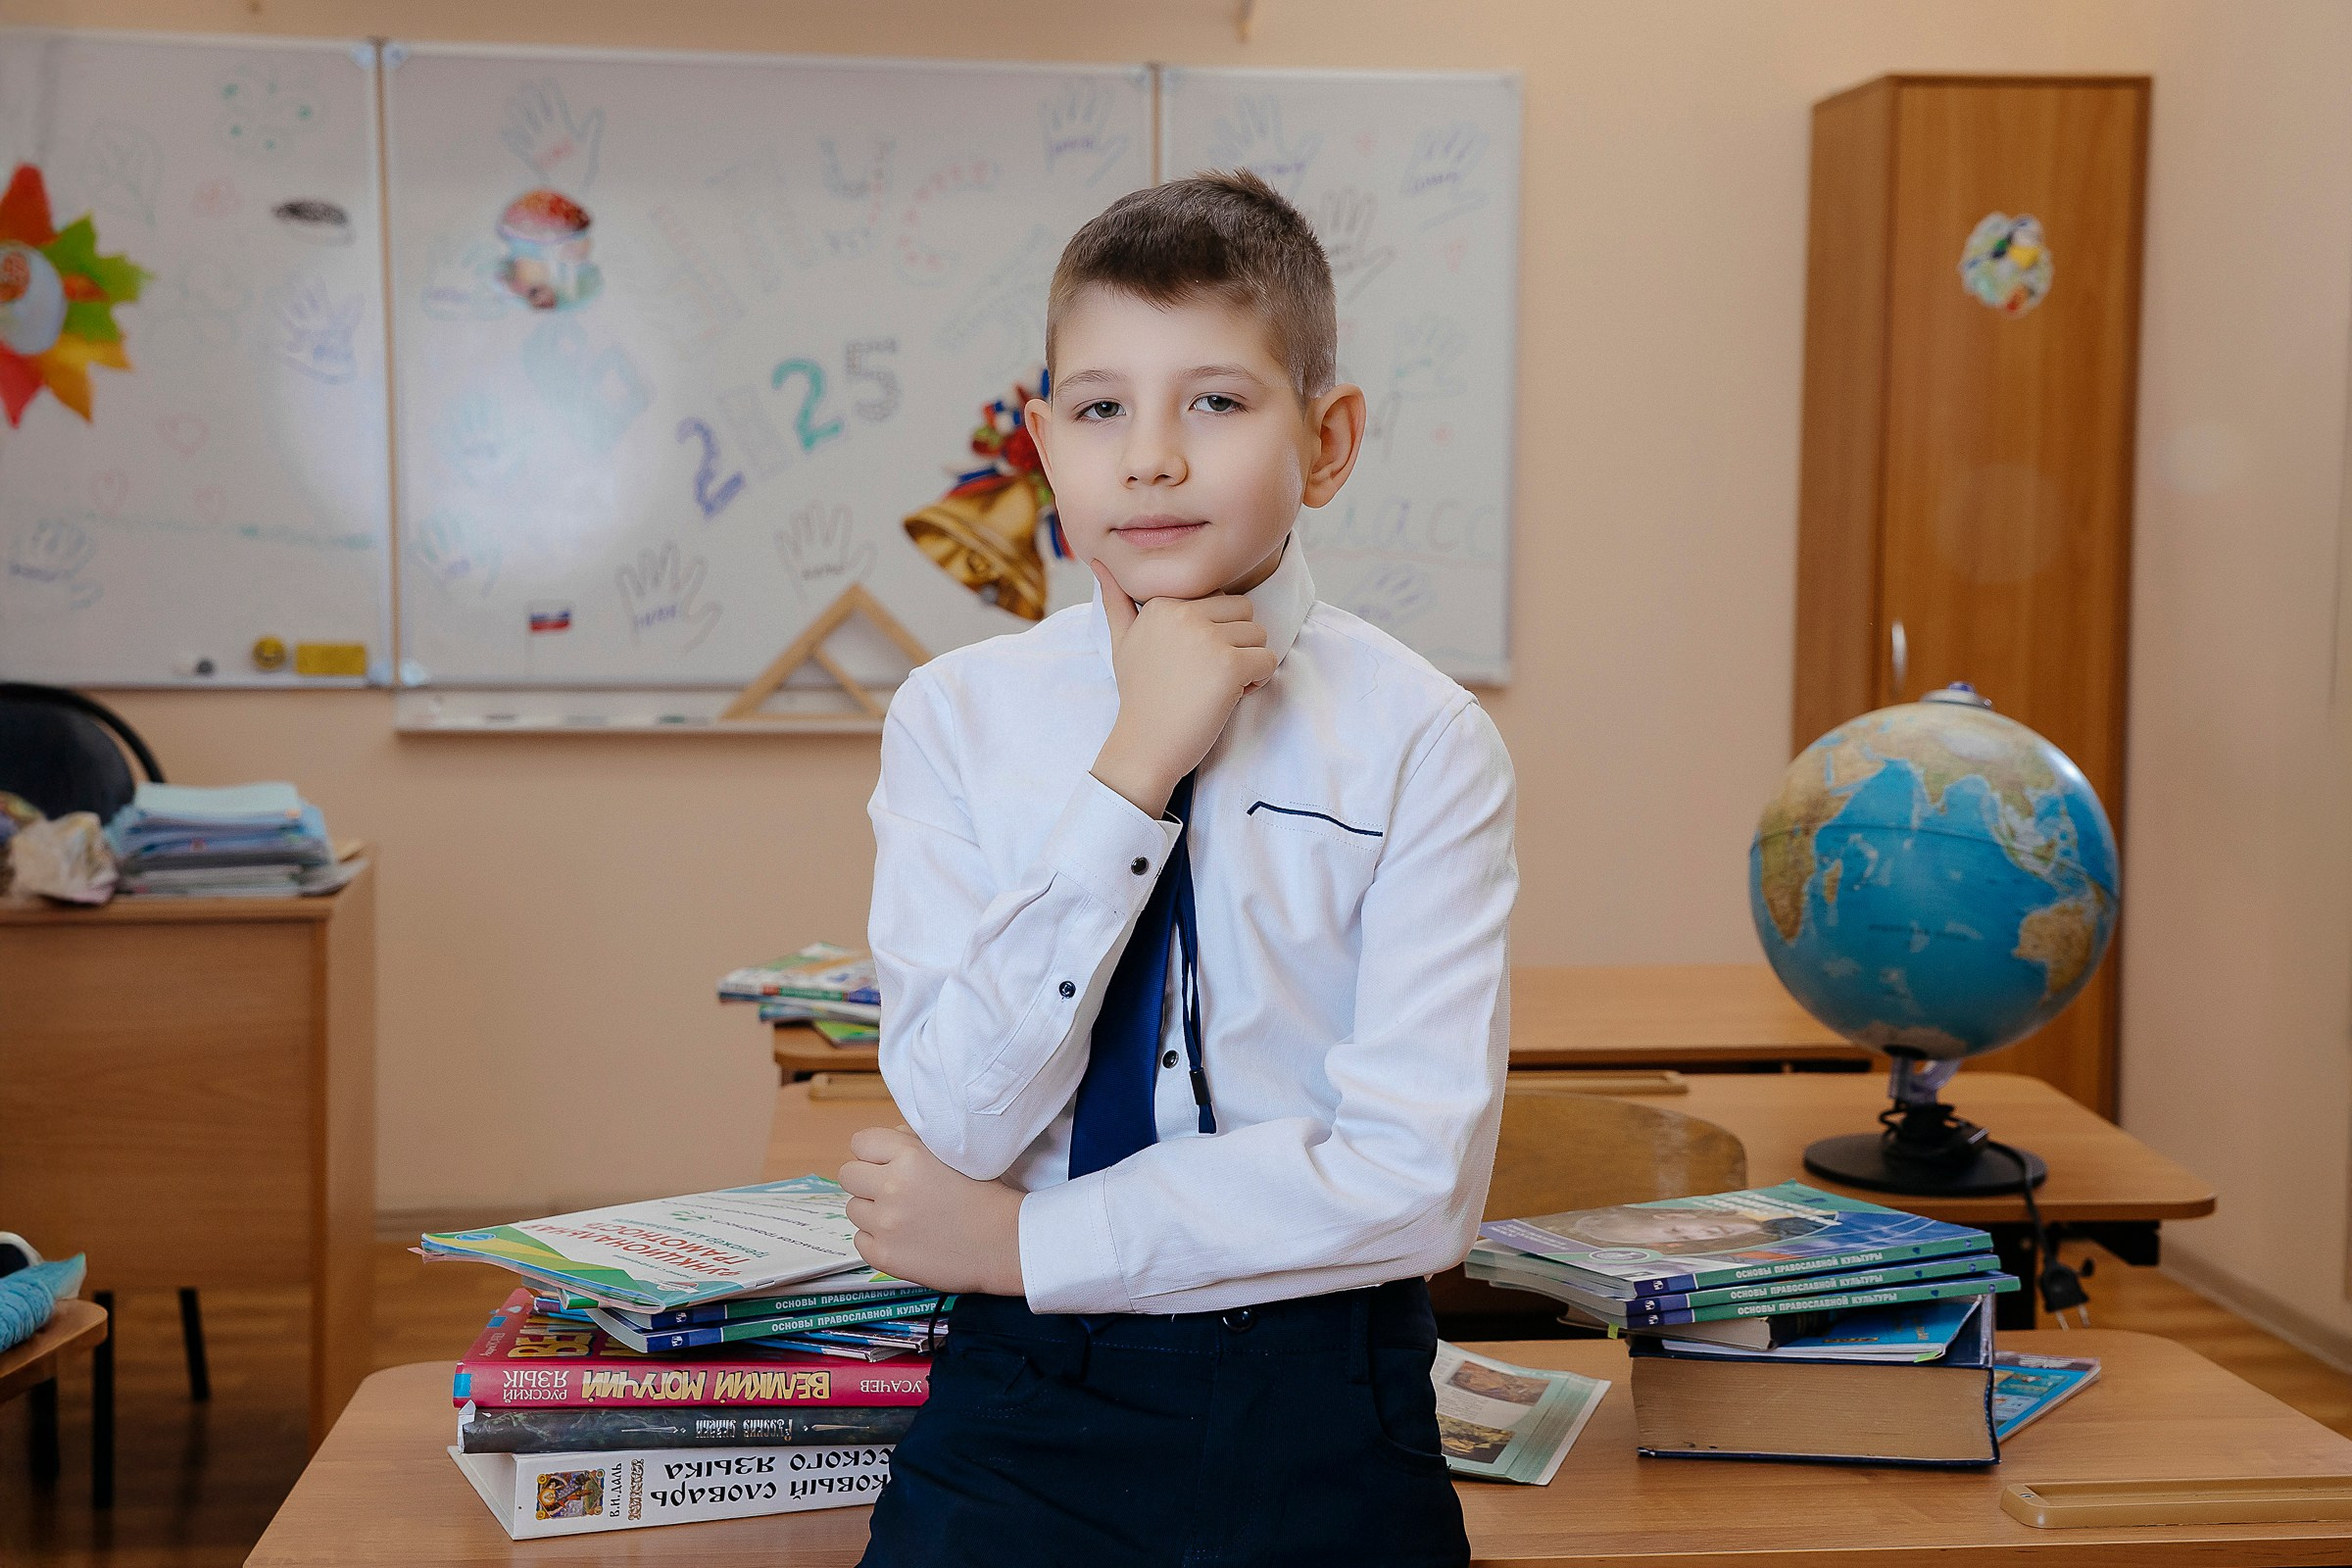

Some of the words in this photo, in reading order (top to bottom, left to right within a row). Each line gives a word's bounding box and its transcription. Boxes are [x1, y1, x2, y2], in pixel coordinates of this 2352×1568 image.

[521, 1224, 742, 1278] ФУНКЦИОНАЛЬНАЯ
[585, 1222, 752, 1265] ГРАМОТНОСТЬ
[1736, 1266, 1772, 1279] ОСНОВЫ
[1775, 1256, 1838, 1274] ПРАВОСЛАВНОЙ
[1841, 1251, 1883, 1265] КУЛЬТУРЫ
[1730, 1287, 1767, 1299] ОСНОВЫ
[1771, 1278, 1838, 1295] ПРАВОСЛАВНОЙ
[1840, 1274, 1883, 1287] КУЛЬТУРЫ
[775, 1298, 817, 1310] ОСНОВЫ
[821, 1289, 895, 1304] ПРАВОСЛАВНОЙ
[1738, 1302, 1776, 1315] ОСНОВЫ
[1779, 1295, 1849, 1311] ПРАВОСЛАВНОЙ
[1851, 1292, 1897, 1304] КУЛЬТУРЫ
[771, 1317, 813, 1332] ОСНОВЫ
[817, 1306, 893, 1327] ПРАВОСЛАВНОЙ
[503, 1370, 569, 1388] ЯЗЫК
[581, 1370, 707, 1402] МОГУЧИЙ
[713, 1370, 830, 1403] ВЕЛИКИЙ
[860, 1379, 922, 1394] УСАЧЕВ
[503, 1389, 567, 1403] РУССКИЙ
